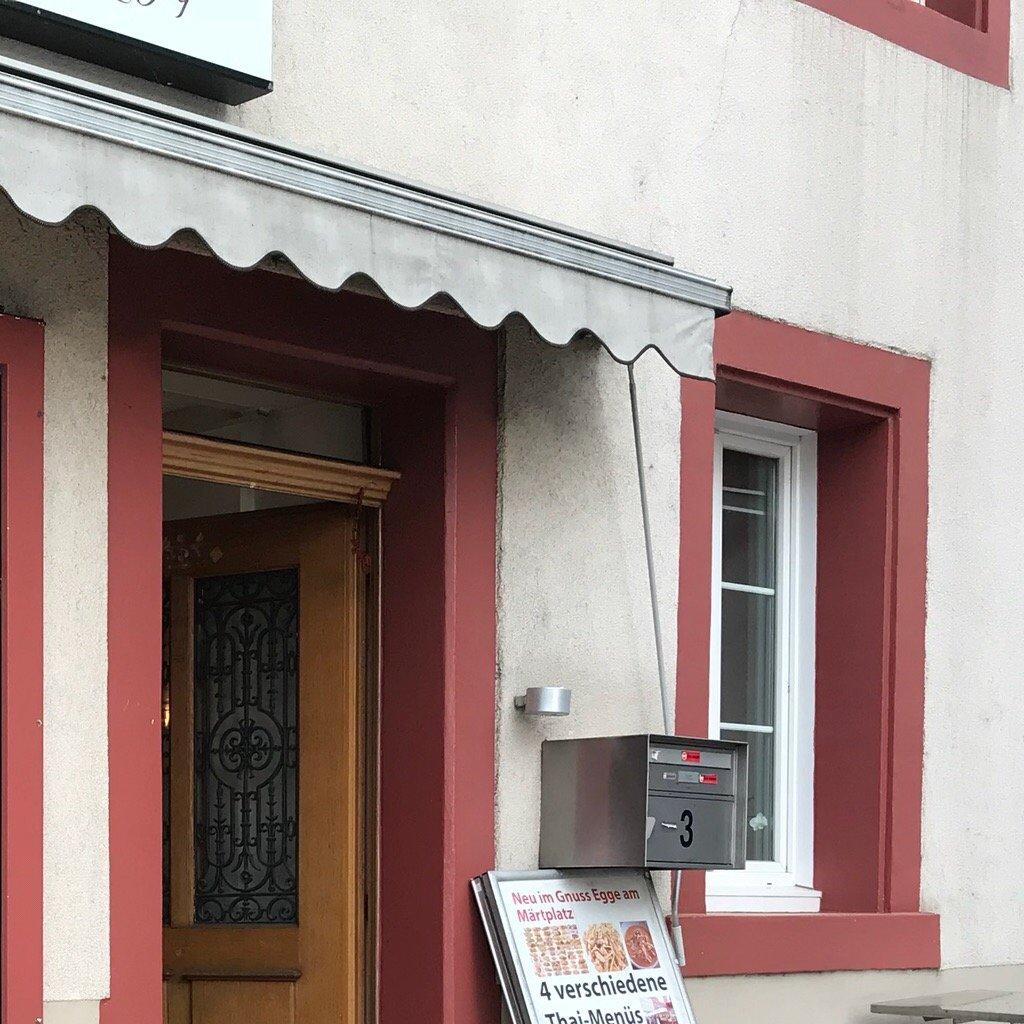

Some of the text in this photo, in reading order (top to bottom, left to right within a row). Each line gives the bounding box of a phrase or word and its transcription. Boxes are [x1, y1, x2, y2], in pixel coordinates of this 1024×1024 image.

[679, 809, 694, 848] 3
[512, 888, 640, 904] Neu im Gnuss Egge am
[517, 907, 574, 924] Märtplatz
[540, 973, 668, 1000] 4 verschiedene
